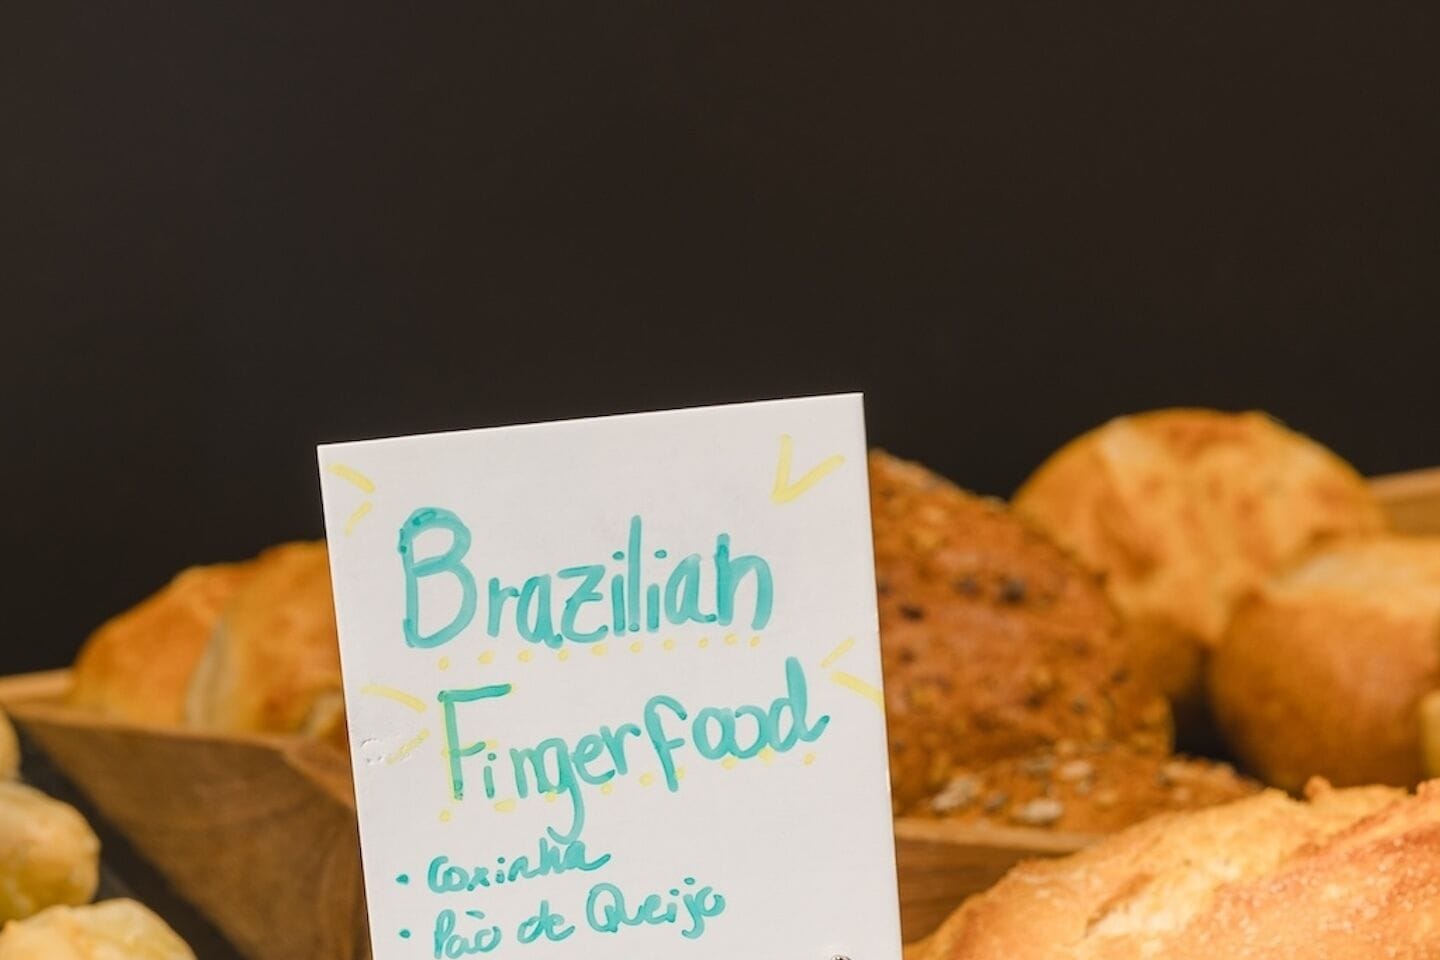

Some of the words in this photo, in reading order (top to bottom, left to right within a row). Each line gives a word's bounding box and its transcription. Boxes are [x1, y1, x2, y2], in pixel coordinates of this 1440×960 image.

[398, 507, 774, 649] Brazilian
[438, 656, 831, 841] Fingerfood
[517, 901, 576, 943] de
[586, 877, 726, 939] Queijo
